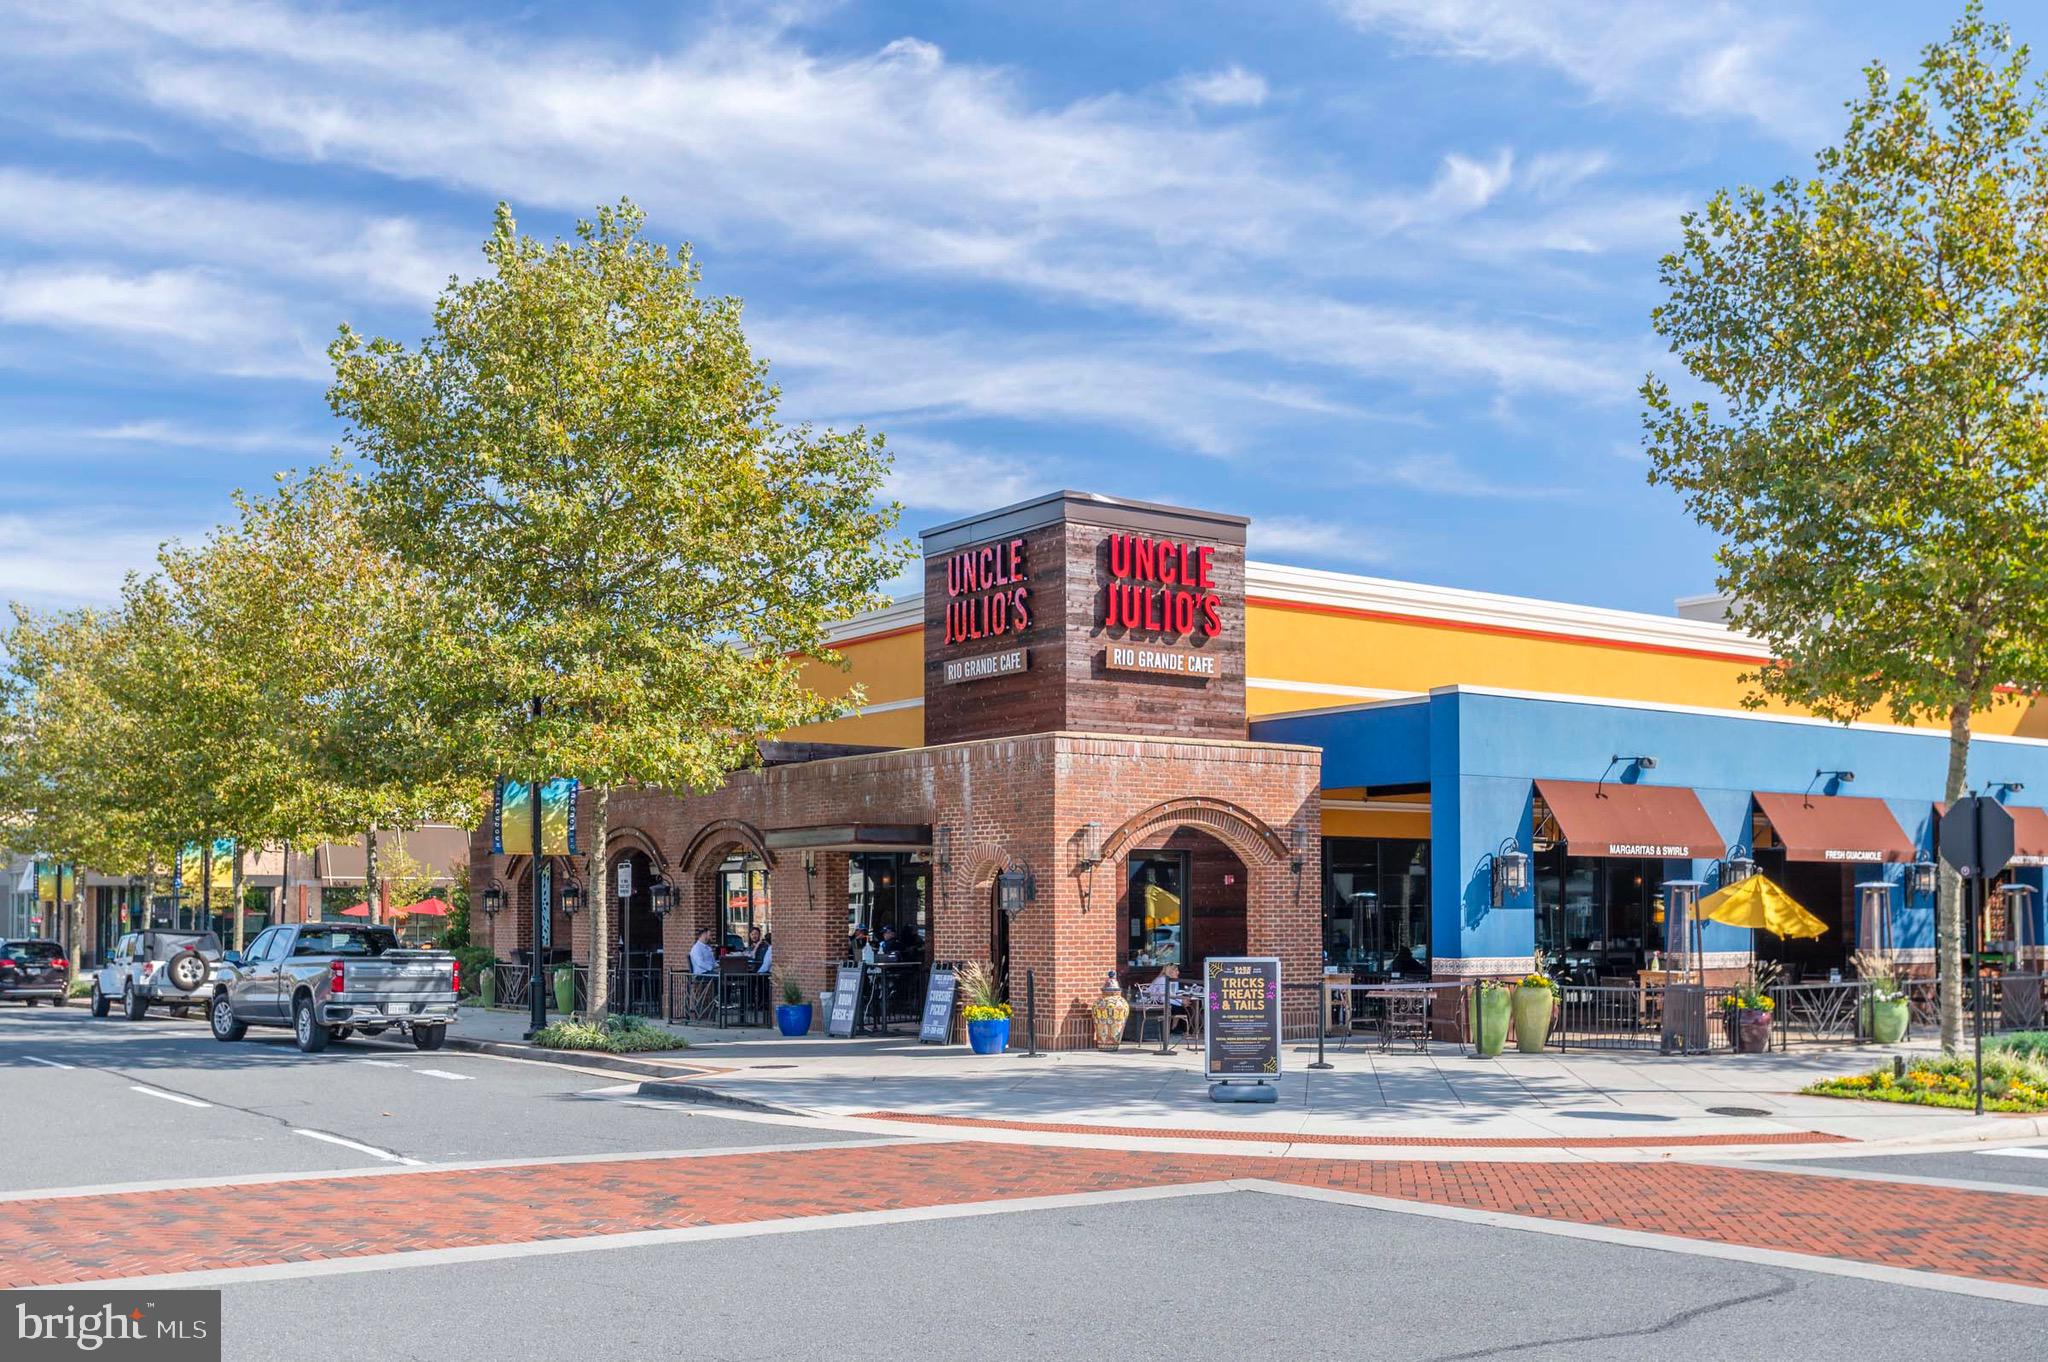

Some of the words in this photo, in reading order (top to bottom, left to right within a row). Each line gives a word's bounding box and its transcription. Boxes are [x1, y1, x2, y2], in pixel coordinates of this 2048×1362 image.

[947, 539, 1025, 598] UNCLE
[1108, 533, 1216, 589] UNCLE
[943, 586, 1029, 646] JULIO'S
[1105, 582, 1222, 638] JULIO'S
[948, 663, 962, 681] RIO
[964, 656, 998, 678] GRANDE
[1000, 652, 1021, 672] CAFE
[1113, 648, 1135, 667] RIO
[1138, 650, 1185, 671] GRANDE
[1187, 655, 1215, 674] CAFE
[1609, 844, 1655, 855] MARGARITAS
[1656, 846, 1662, 856] &
[1662, 846, 1689, 857] SWIRLS
[1221, 977, 1265, 989] TRICKS
[1221, 989, 1265, 999] TREATS
[1222, 1000, 1231, 1011] &
[1233, 1000, 1265, 1011] TAILS
